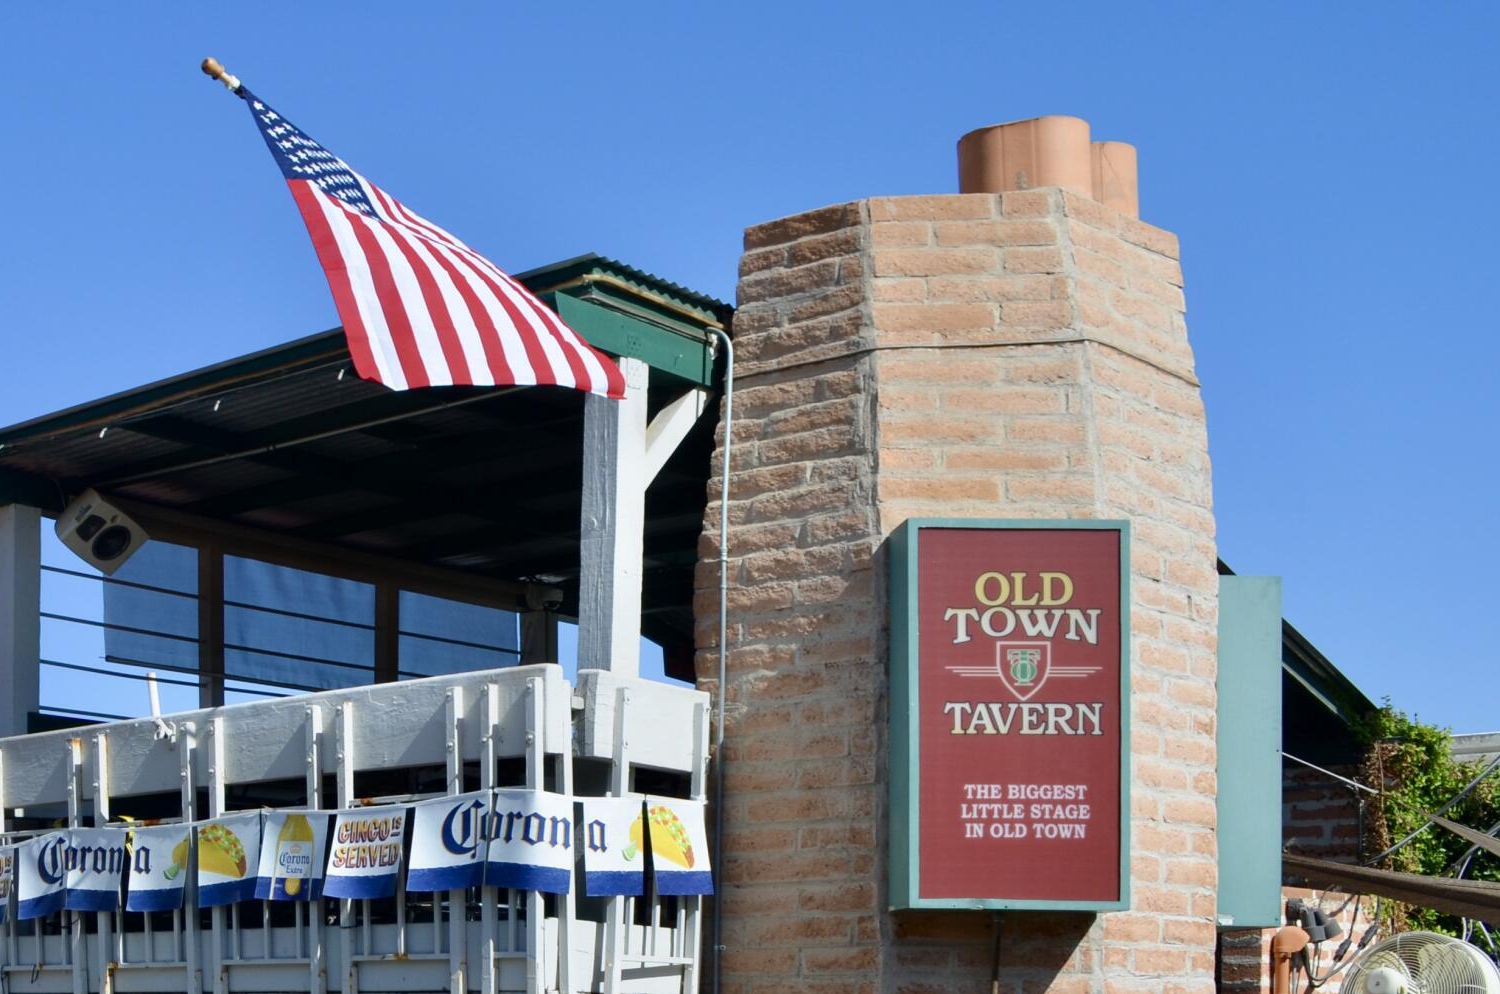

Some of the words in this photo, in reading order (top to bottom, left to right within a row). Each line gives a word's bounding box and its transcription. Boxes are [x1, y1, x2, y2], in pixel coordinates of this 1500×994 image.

[973, 571, 1075, 607] OLD
[942, 606, 1103, 646] TOWN
[943, 701, 1104, 736] TAVERN
[963, 783, 1003, 800] THE
[1007, 783, 1088, 800] BIGGEST
[960, 803, 1026, 820] LITTLE
[1030, 803, 1091, 820] STAGE
[337, 818, 391, 844] CINCO
[391, 815, 403, 831] IS
[441, 799, 608, 860] Corona
[964, 822, 986, 839] IN
[989, 822, 1028, 839] OLD
[1032, 822, 1086, 839] TOWN
[37, 836, 153, 887] Corona
[279, 851, 310, 866] Corona
[332, 843, 401, 868] SERVED
